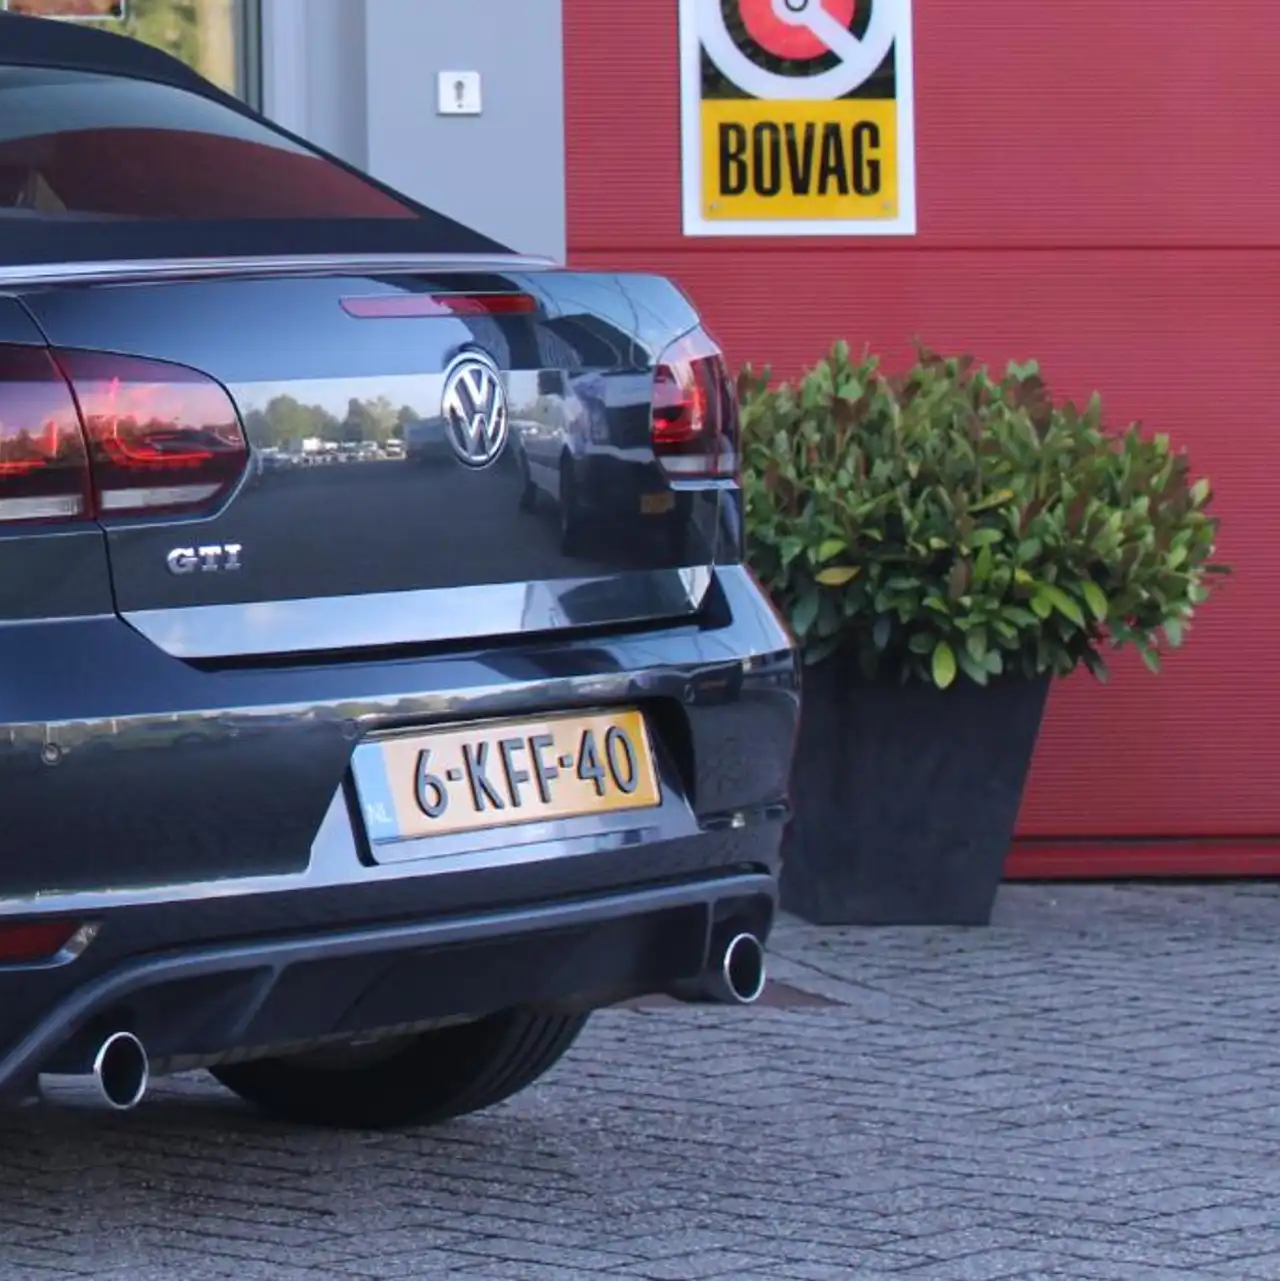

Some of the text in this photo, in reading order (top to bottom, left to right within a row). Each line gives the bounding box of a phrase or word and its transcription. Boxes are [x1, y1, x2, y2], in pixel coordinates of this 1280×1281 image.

[718, 121, 880, 197] BOVAG
[167, 544, 242, 575] GTI
[414, 725, 640, 819] 6-KFF-40
